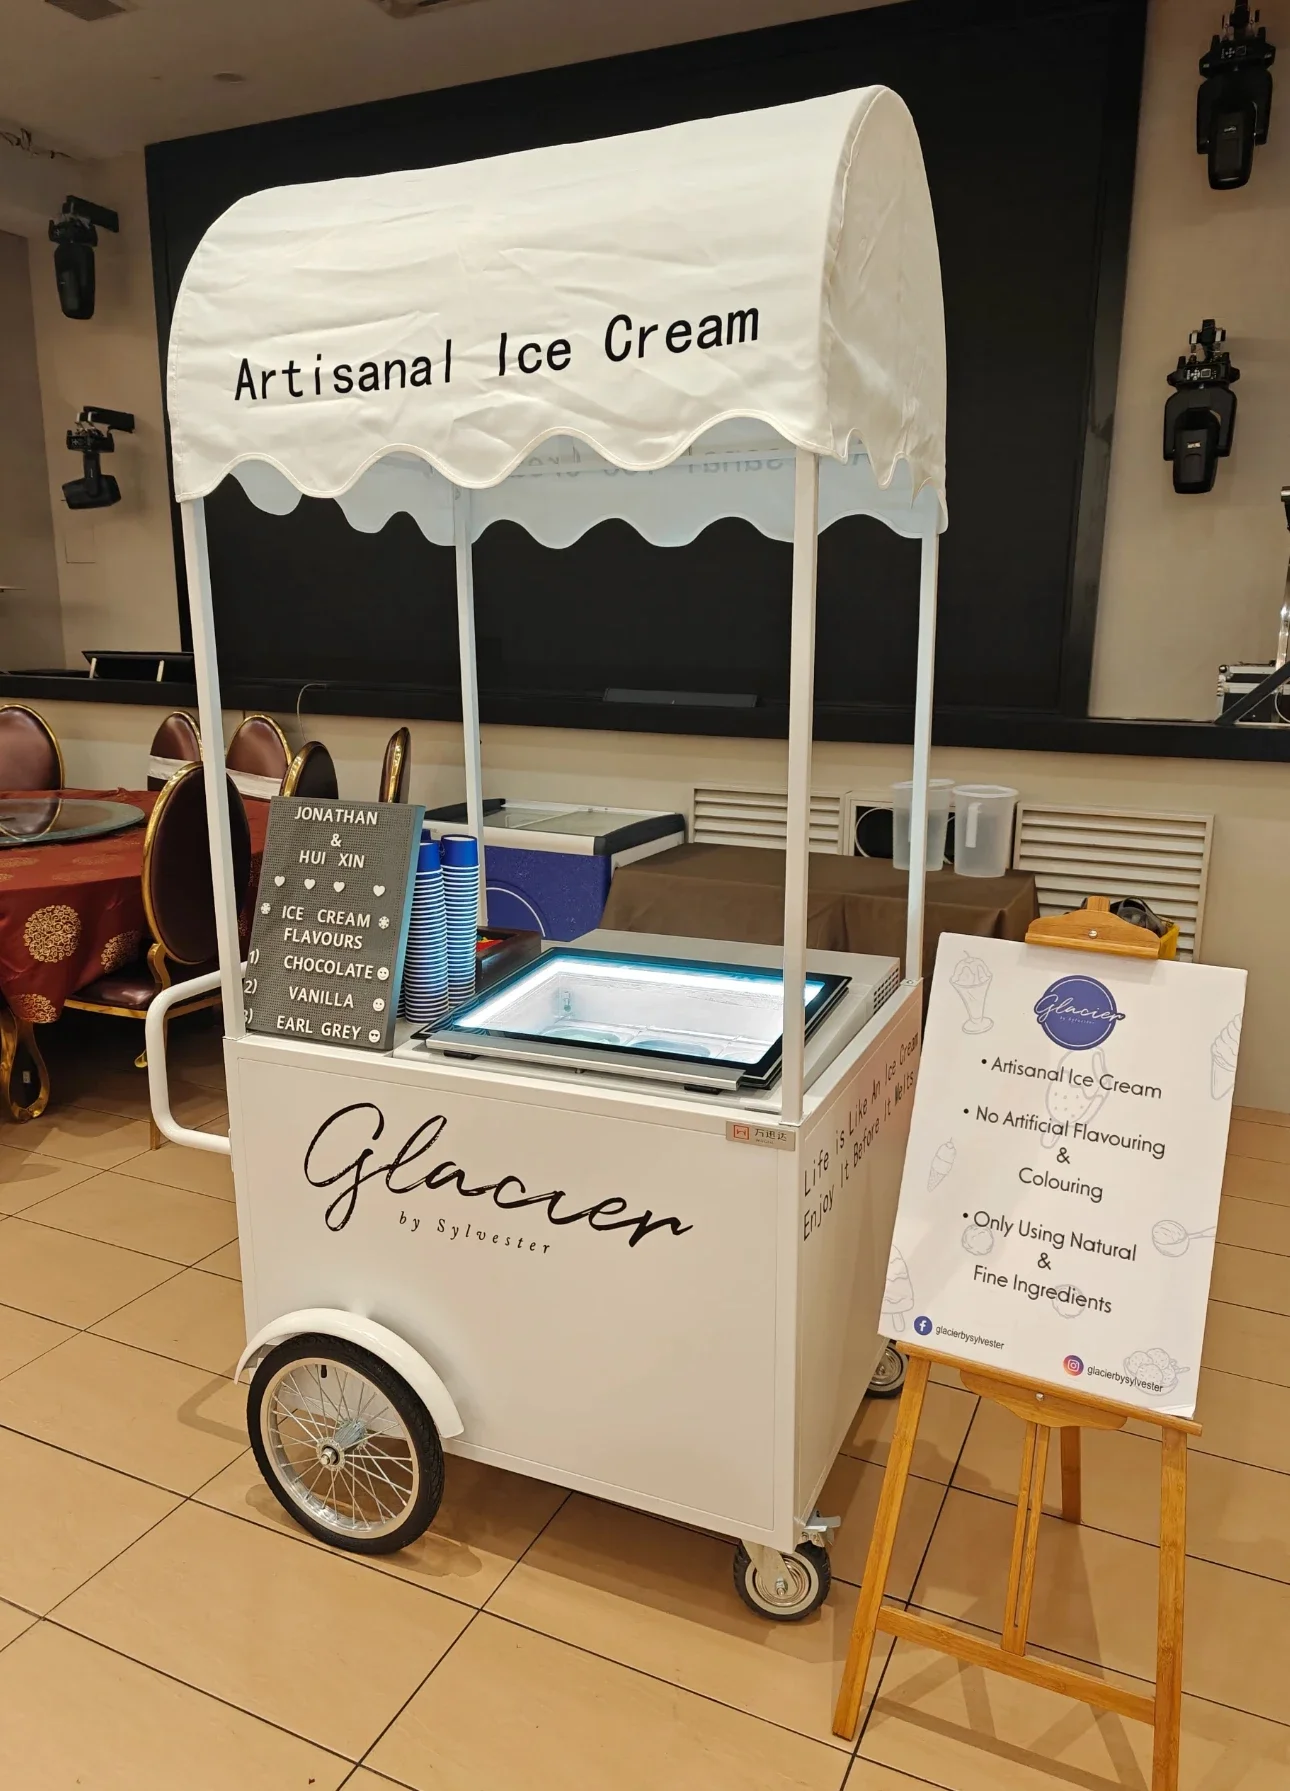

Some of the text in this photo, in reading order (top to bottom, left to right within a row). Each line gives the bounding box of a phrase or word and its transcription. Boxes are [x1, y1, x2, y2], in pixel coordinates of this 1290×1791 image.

[234, 307, 760, 401] Artisanal Ice Cream
[295, 806, 378, 826] JONATHAN
[330, 833, 342, 848] &
[299, 850, 365, 869] HUI XIN
[281, 905, 371, 928] ICE CREAM
[283, 928, 363, 950] FLAVOURS
[249, 948, 374, 980] 1) CHOCOLATE
[243, 978, 354, 1009] 2) VANILLA
[1036, 994, 1124, 1023] Glacier
[276, 1015, 313, 1034] EARL
[321, 1022, 361, 1041] GREY
[991, 1057, 1162, 1099] Artisanal Ice Cream
[804, 1032, 919, 1197] Life is Like An Ice Cream
[976, 1105, 1166, 1160] No Artificial Flavouring
[803, 1070, 914, 1242] Enjoy It Before It Melts
[1056, 1147, 1071, 1165] &
[303, 1102, 693, 1248] Glacier
[1018, 1167, 1103, 1203] Colouring
[399, 1211, 551, 1255] by Sylvester
[974, 1211, 1137, 1262] Only Using Natural
[1037, 1253, 1052, 1270] &
[973, 1265, 1113, 1314] Fine Ingredients
[936, 1324, 1004, 1350] glacierbysylvester
[1087, 1364, 1163, 1393] glacierbysylvester
